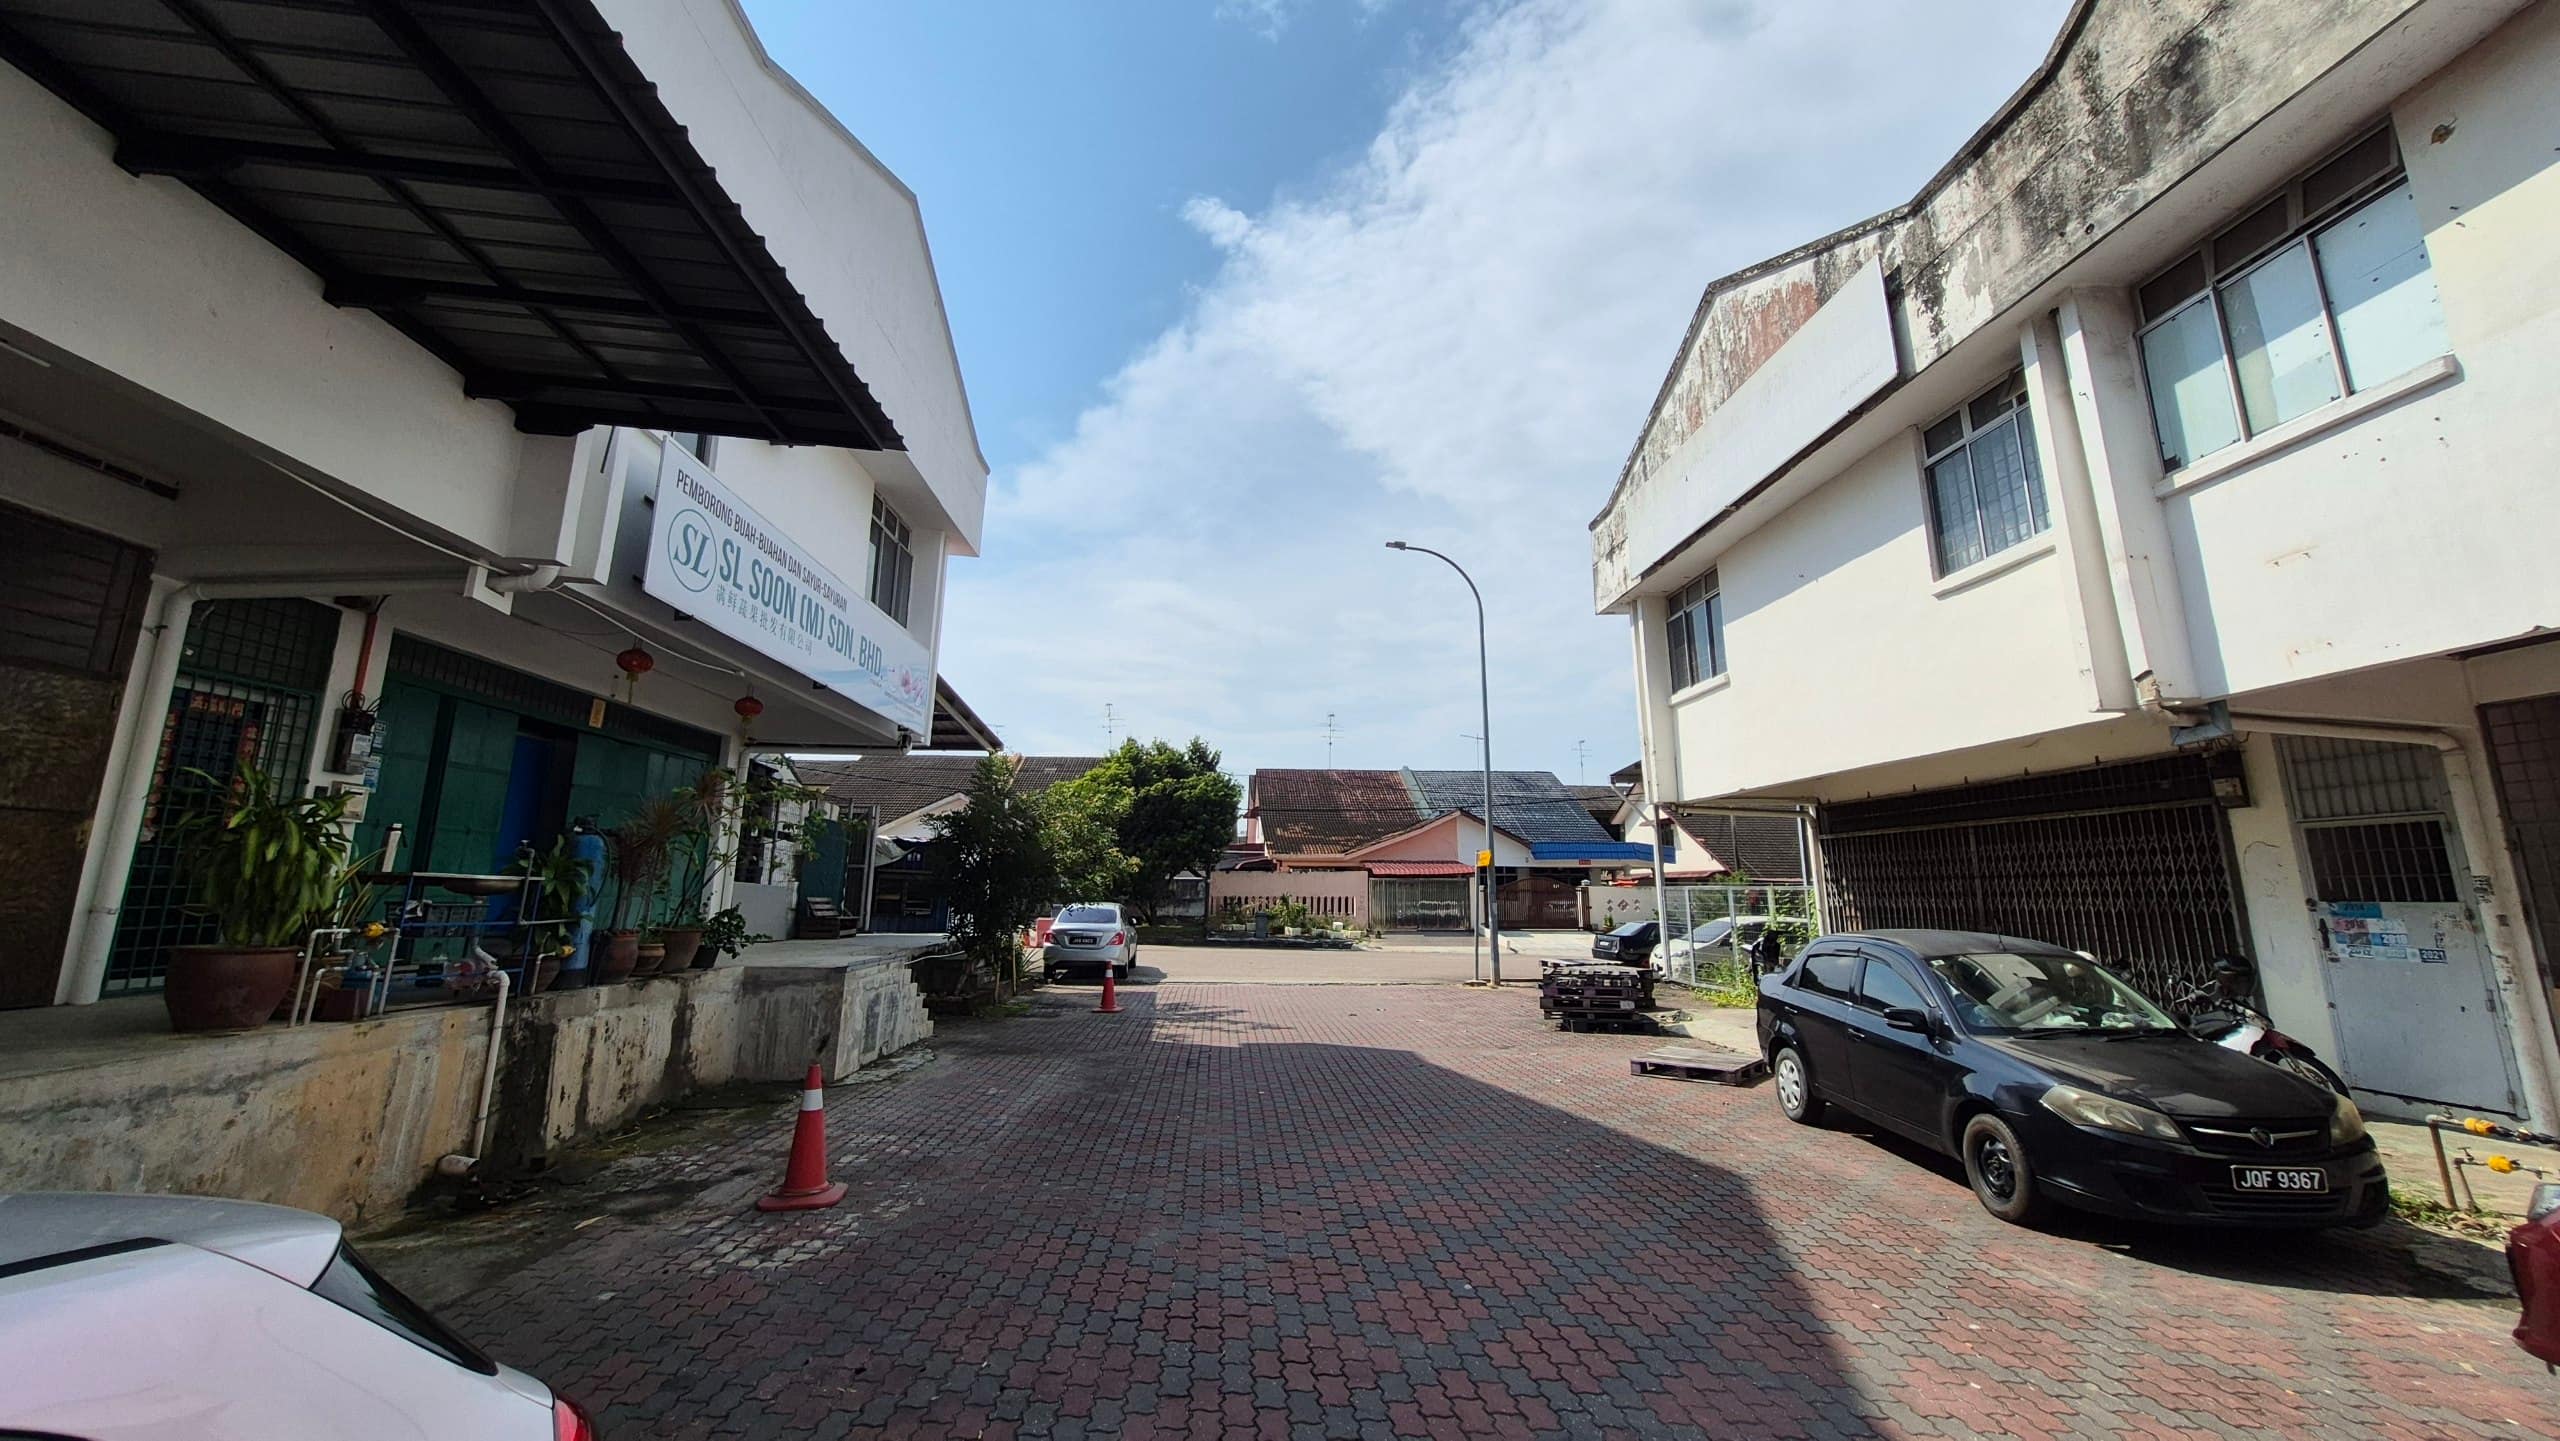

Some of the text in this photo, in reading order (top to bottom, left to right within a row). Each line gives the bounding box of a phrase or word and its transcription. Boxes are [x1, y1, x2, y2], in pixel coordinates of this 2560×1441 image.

[672, 523, 711, 579] SL
[676, 468, 848, 614] PEMBORONG BUAH-BUAHAN DAN SAYUR-SAYURAN
[719, 537, 884, 681] SL SOON (M) SDN. BHD.
[2420, 949, 2445, 960] 2021
[2240, 1169, 2320, 1190] JQF 9367
